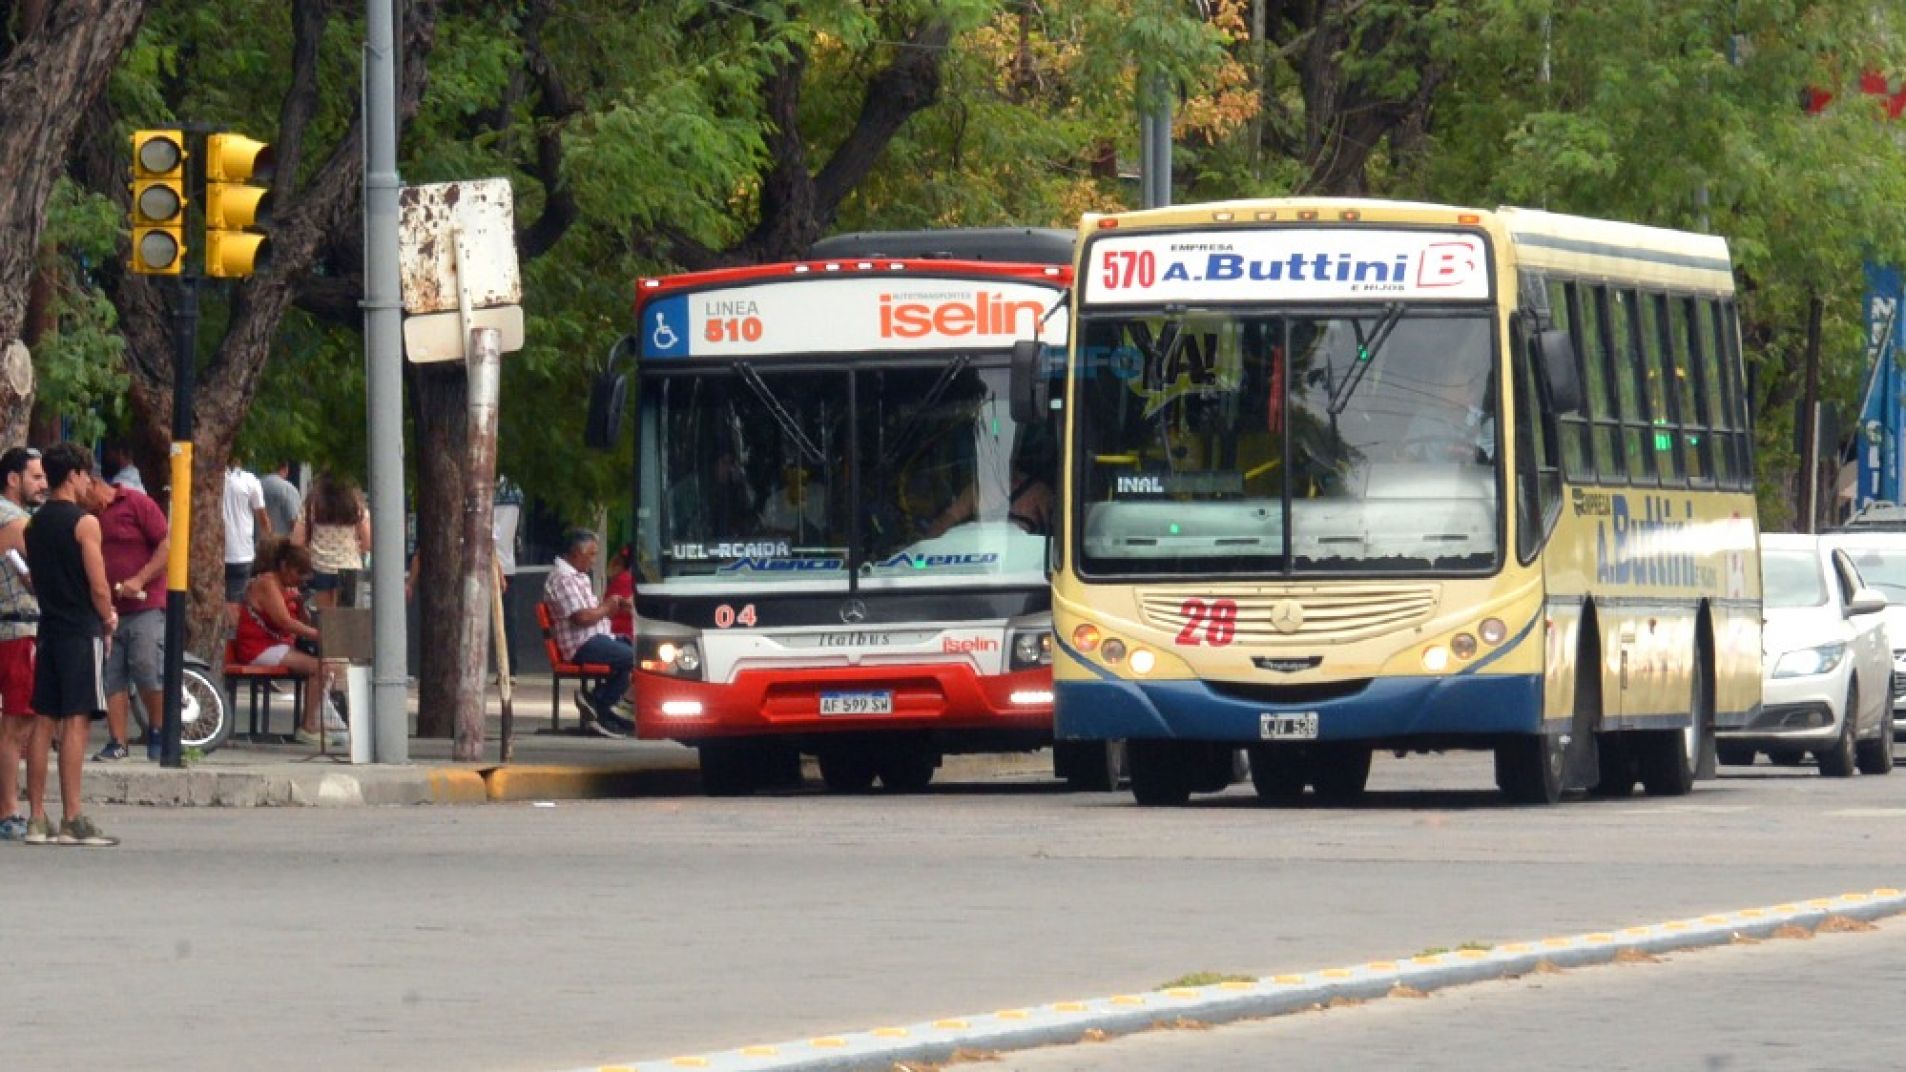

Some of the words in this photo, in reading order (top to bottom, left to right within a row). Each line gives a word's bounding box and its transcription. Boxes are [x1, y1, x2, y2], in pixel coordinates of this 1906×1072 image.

[1102, 250, 1156, 289] 570
[705, 300, 760, 316] LINEA
[704, 317, 764, 342] 510
[1117, 476, 1164, 492] INAL
[714, 603, 758, 629] 04
[1174, 598, 1237, 647] 28
